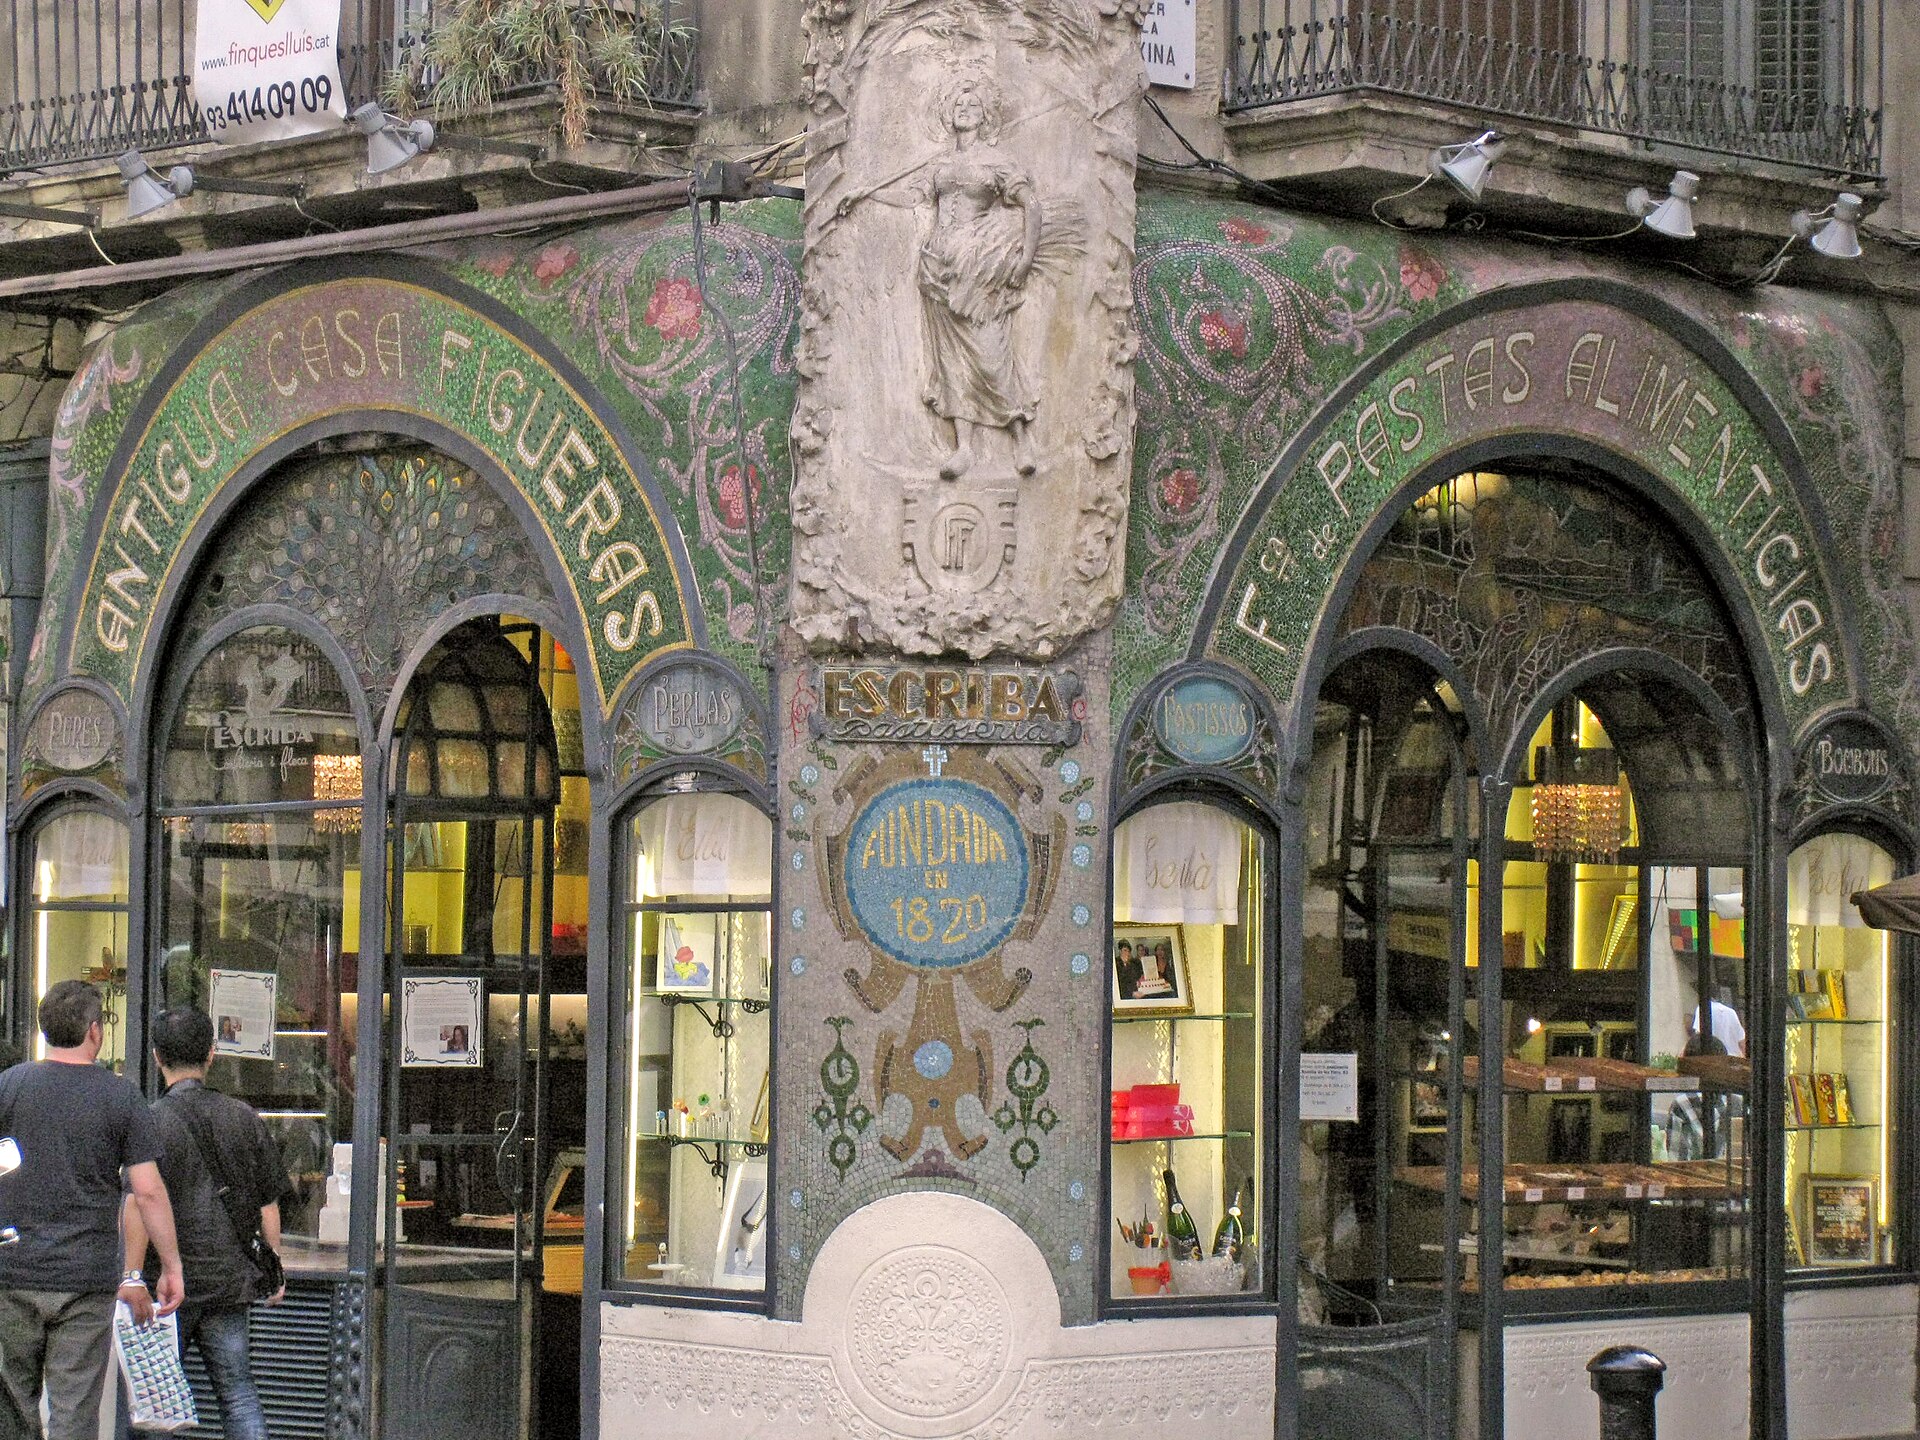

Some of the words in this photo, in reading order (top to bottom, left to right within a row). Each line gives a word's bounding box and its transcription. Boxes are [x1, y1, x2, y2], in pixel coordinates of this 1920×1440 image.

[201, 28, 330, 71] www.finqueslluís.cat
[206, 105, 227, 131] 93
[300, 74, 332, 113] 09
[96, 369, 252, 652] ANTIGUA
[267, 309, 403, 398] CASA
[438, 331, 664, 651] FIGUERAS
[1315, 332, 1535, 519] PASTAS
[1566, 332, 1833, 696] ALIMENTICIAS
[862, 799, 1008, 870] FUNDADA
[924, 870, 949, 889] EN
[889, 894, 988, 944] 1820
